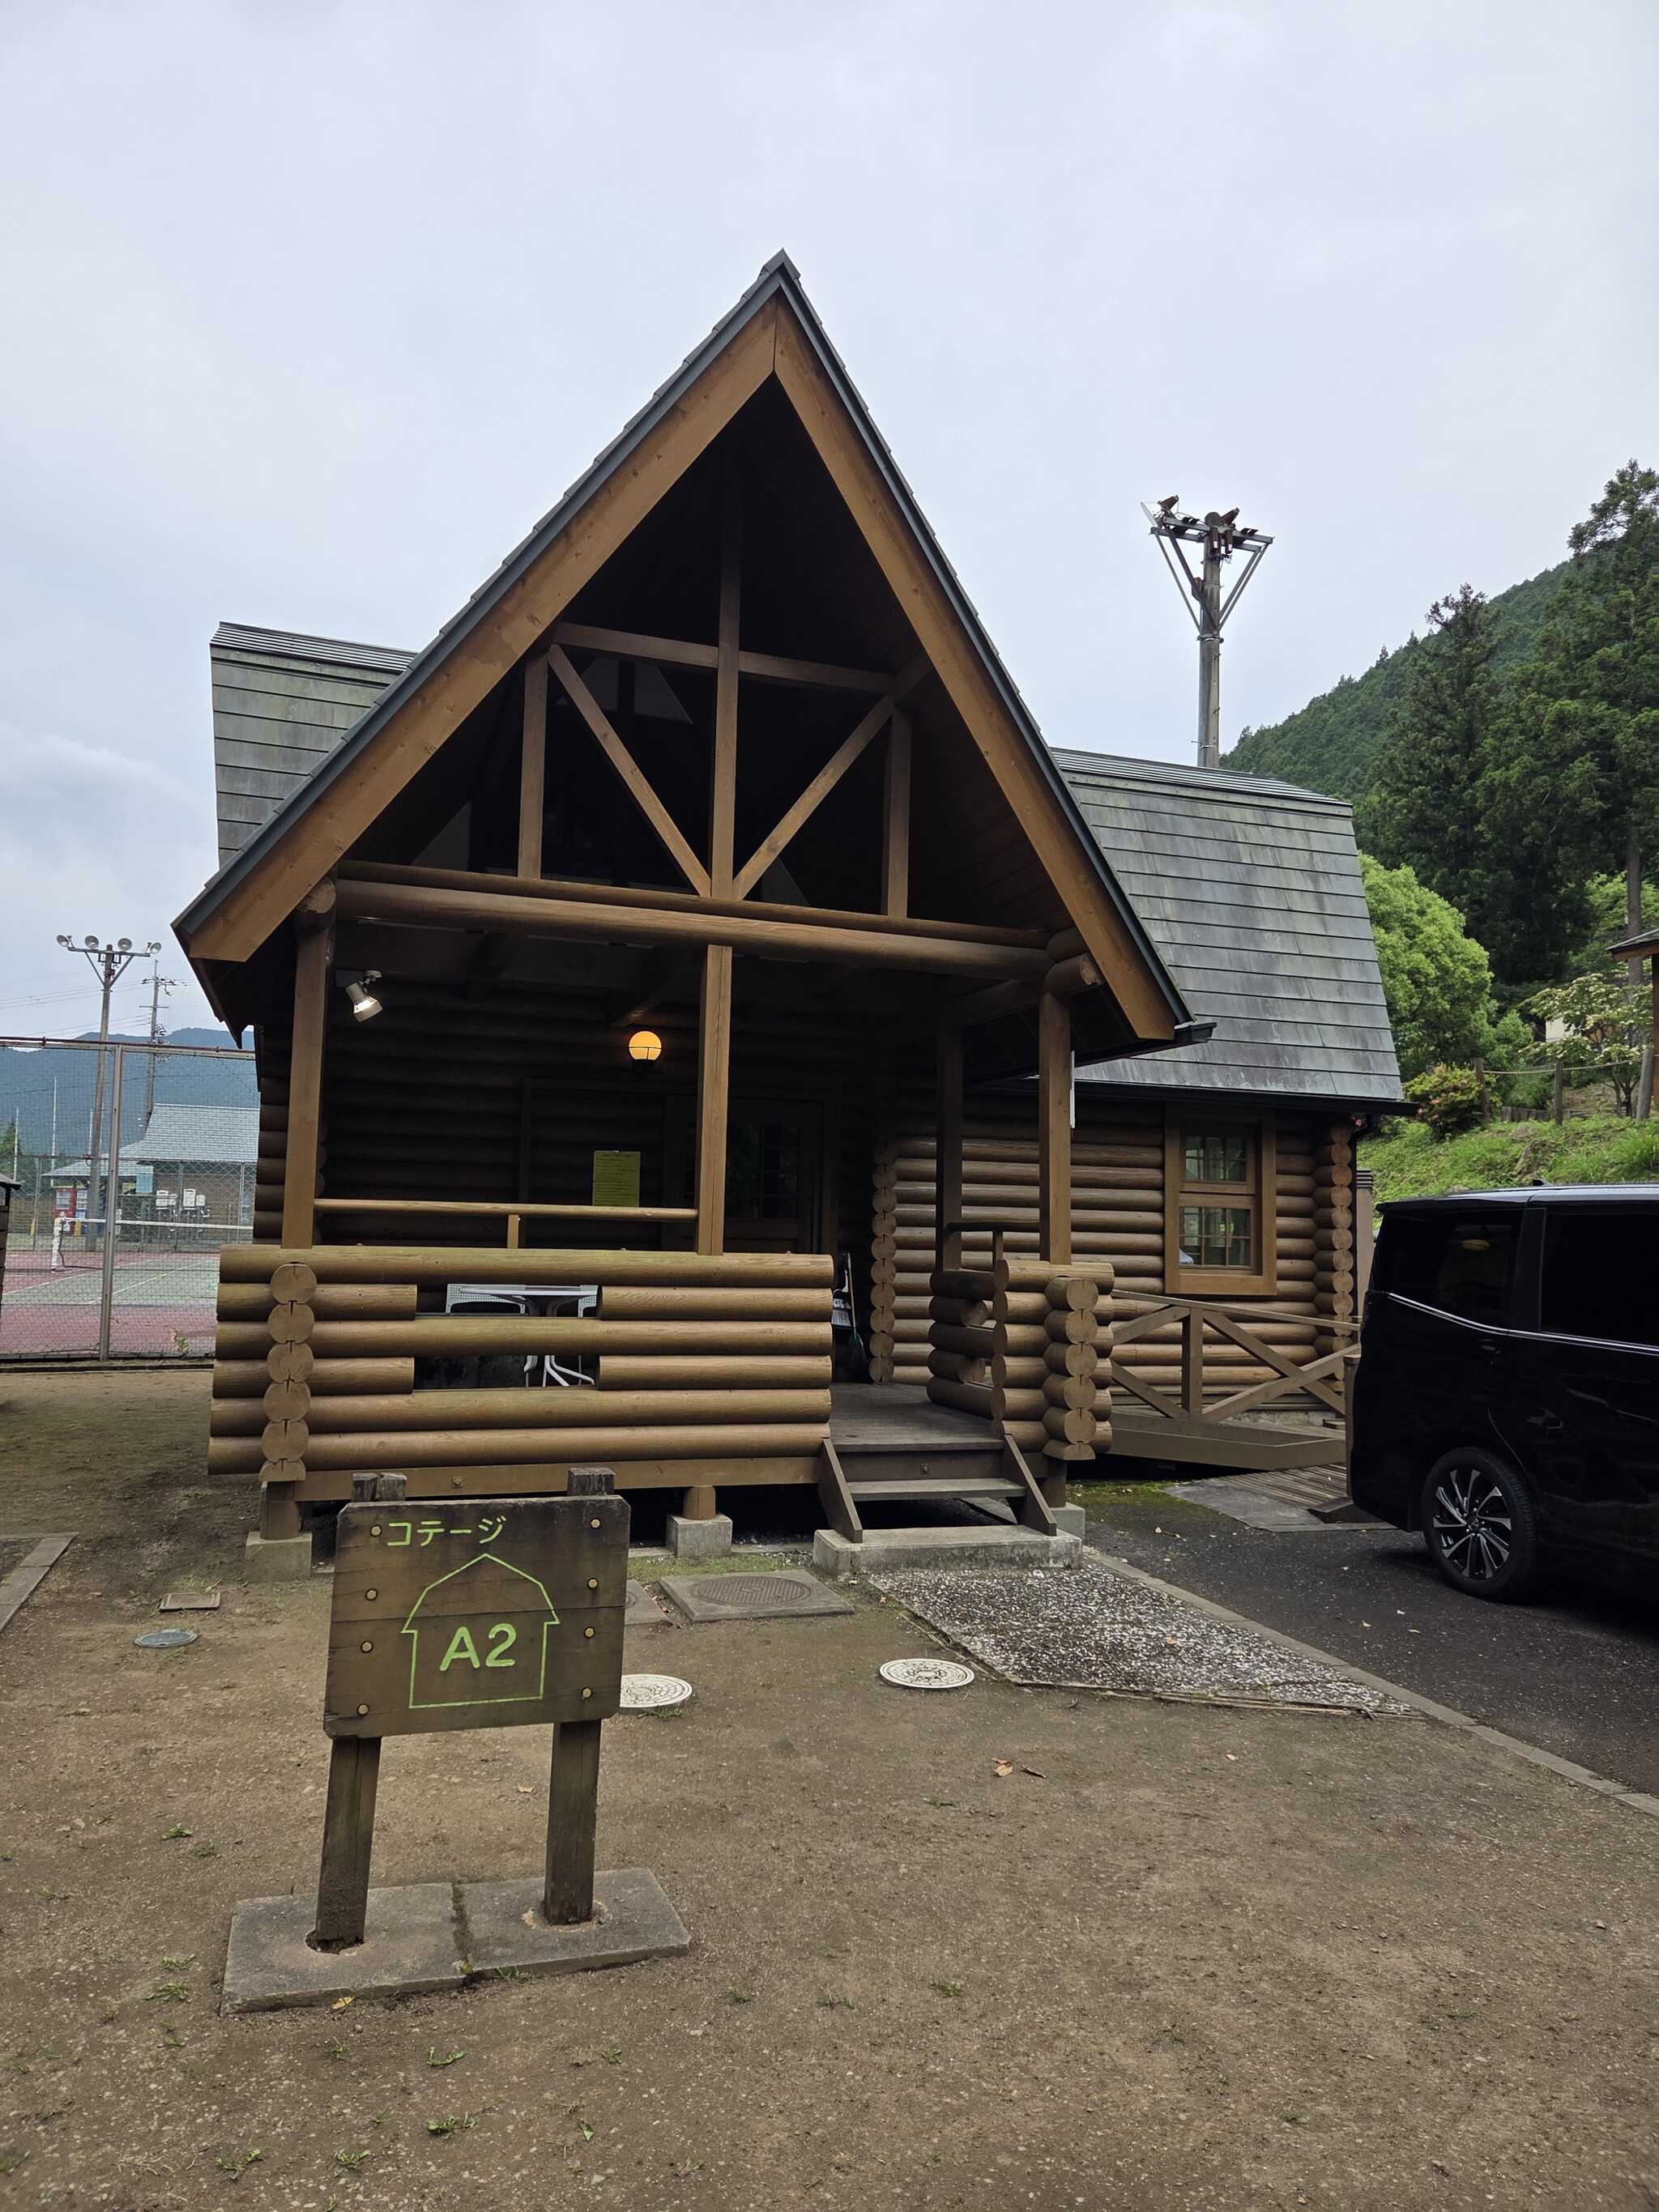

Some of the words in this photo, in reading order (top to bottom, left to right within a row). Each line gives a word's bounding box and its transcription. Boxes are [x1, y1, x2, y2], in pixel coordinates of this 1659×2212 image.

[386, 1515, 507, 1547] コテージ
[439, 1622, 518, 1672] A2
